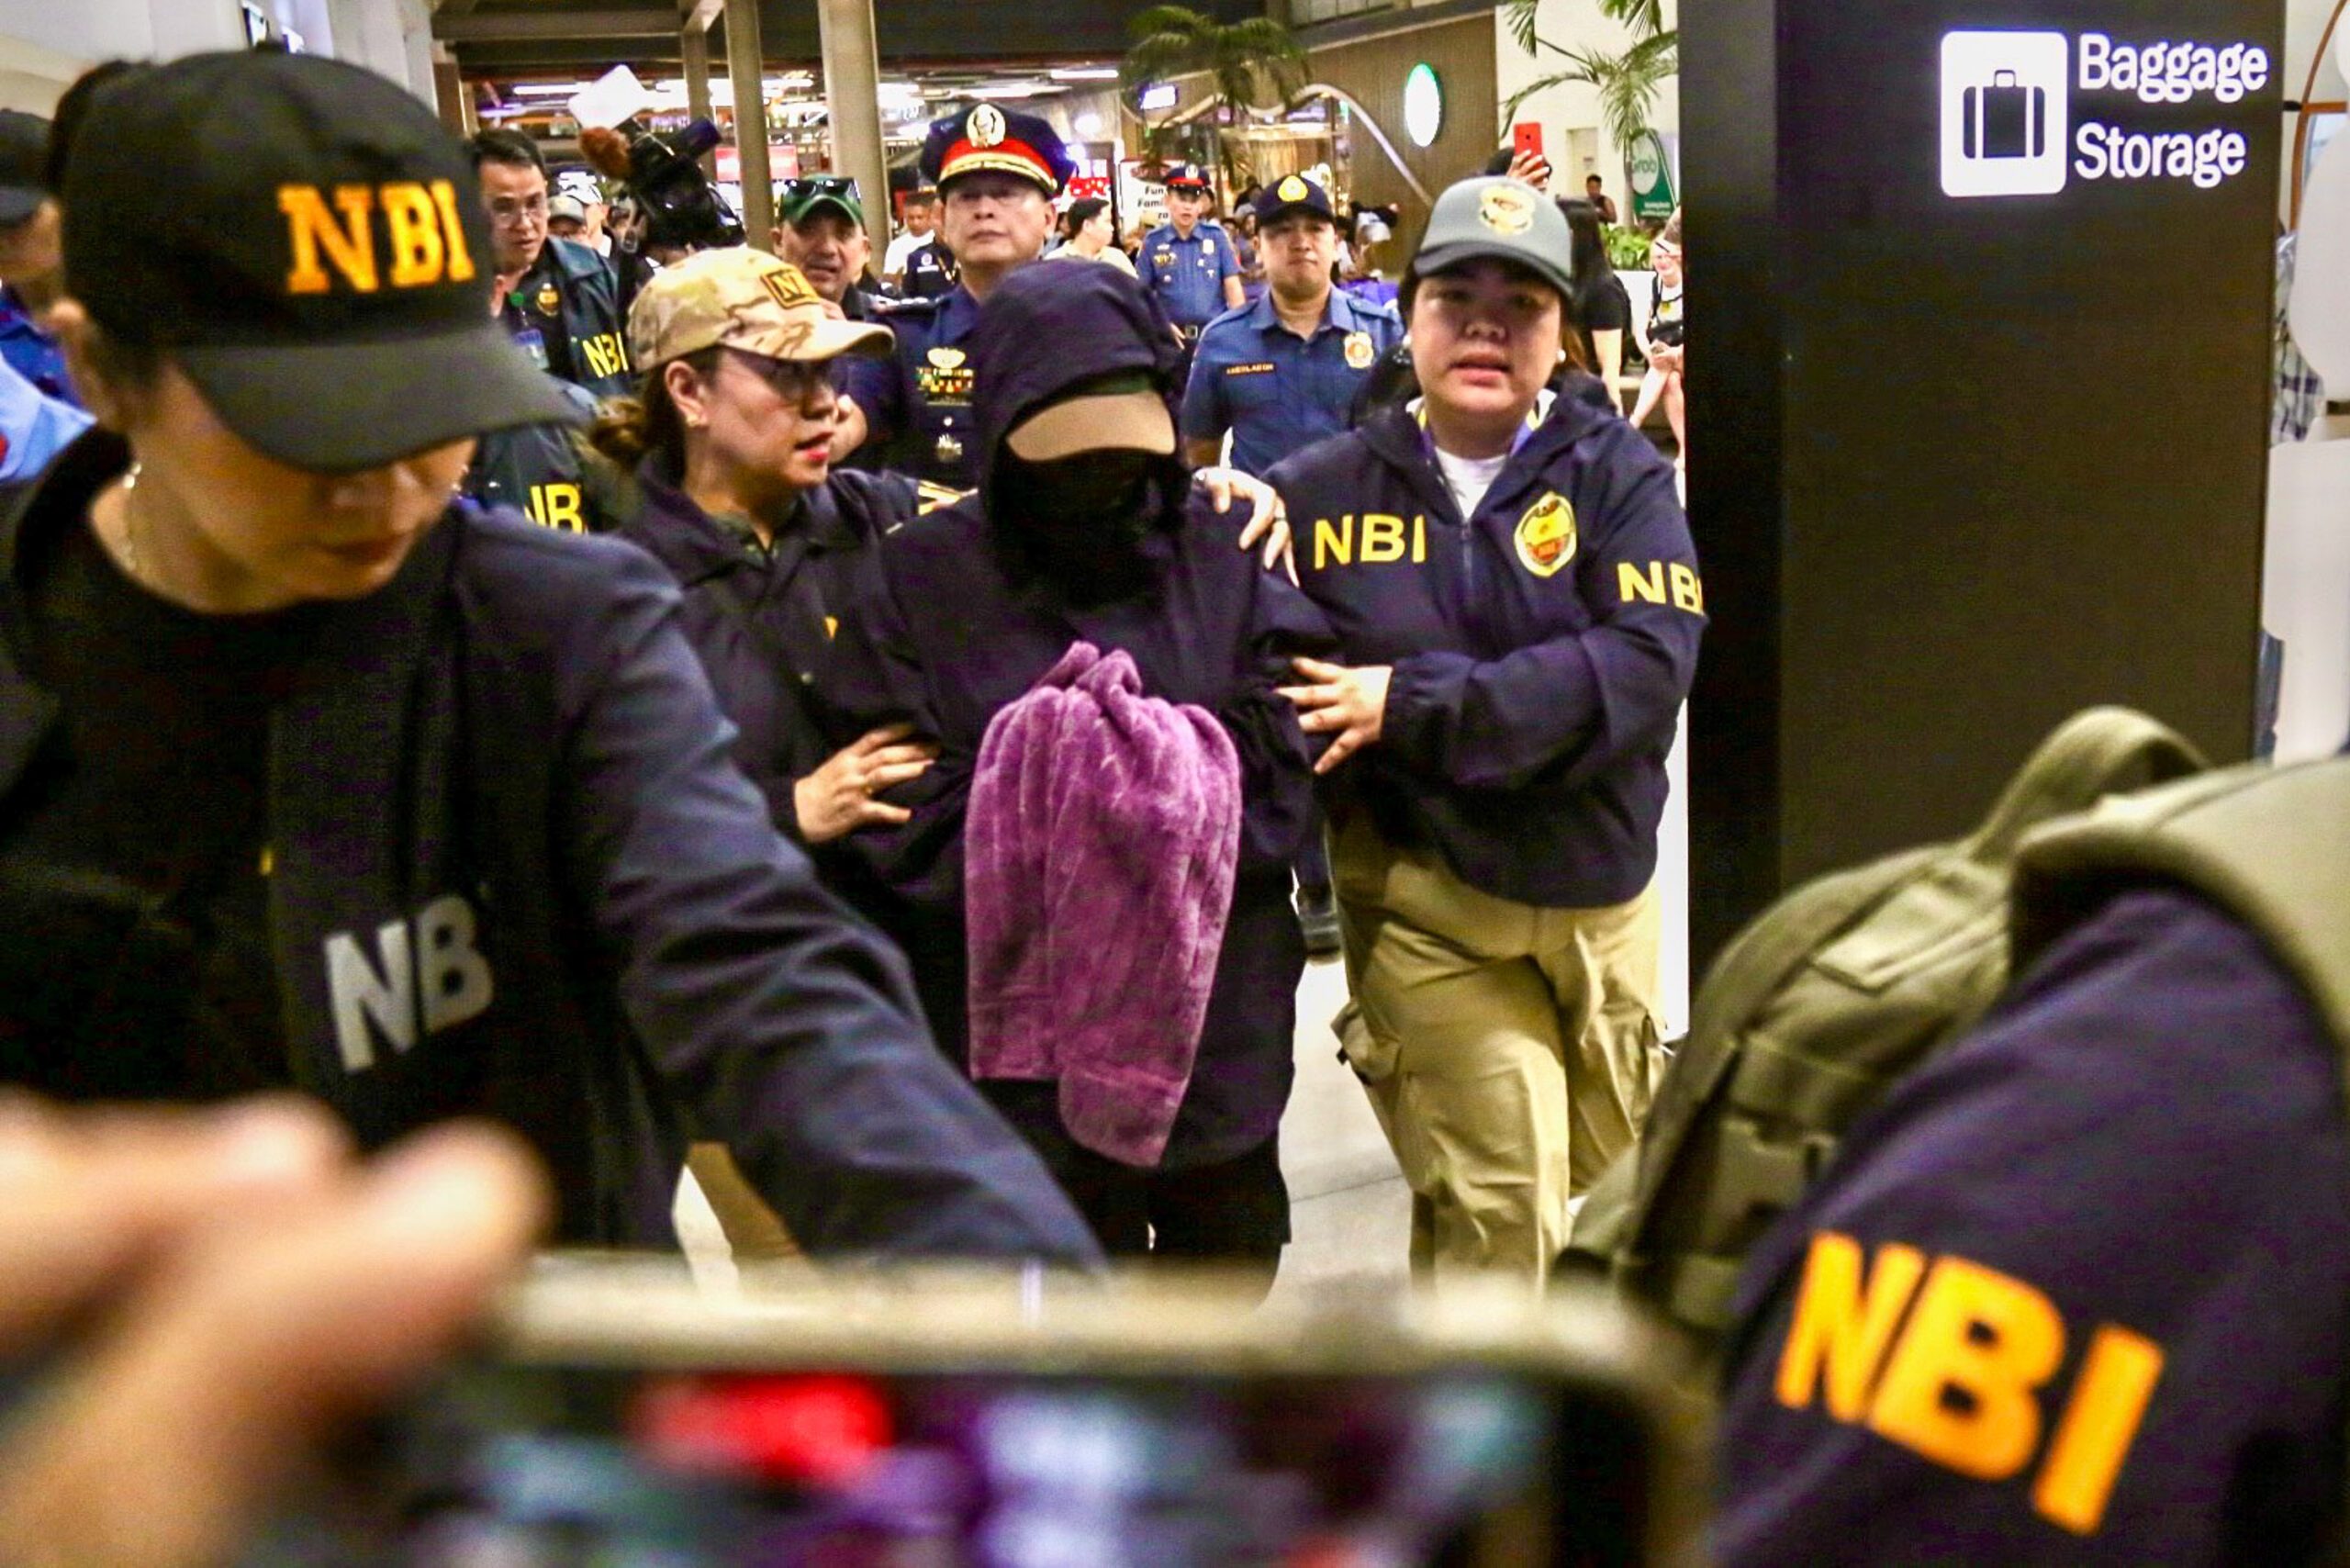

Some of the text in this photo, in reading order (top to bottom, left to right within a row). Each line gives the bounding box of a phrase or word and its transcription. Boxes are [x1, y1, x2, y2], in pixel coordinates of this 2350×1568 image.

[2078, 33, 2267, 103] Baggage
[2075, 122, 2246, 188] Storage
[278, 179, 476, 293] NBI
[1315, 514, 1426, 570] NBI
[1775, 1230, 2164, 1536] NBI
